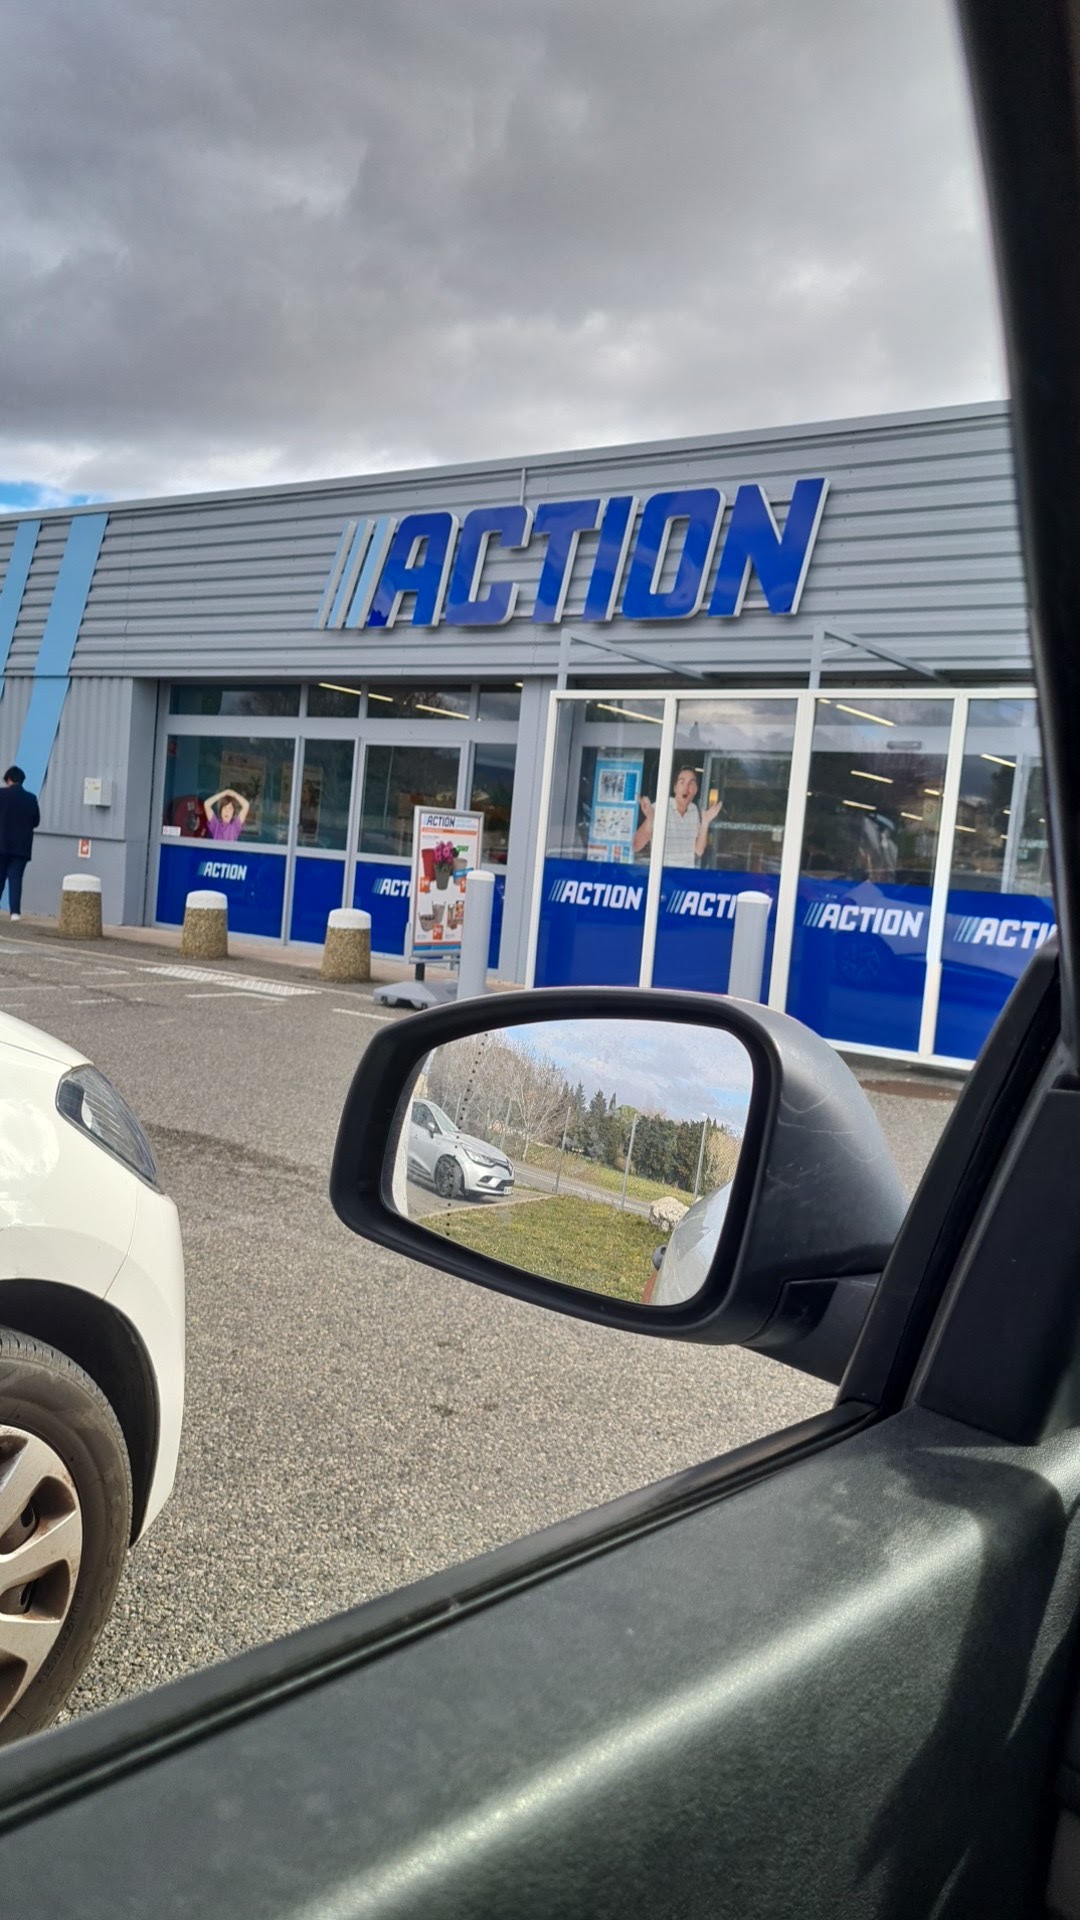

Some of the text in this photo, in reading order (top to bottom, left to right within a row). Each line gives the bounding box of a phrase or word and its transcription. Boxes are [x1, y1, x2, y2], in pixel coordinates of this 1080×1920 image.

[368, 478, 831, 628] ACTION
[427, 815, 455, 828] ACTION
[203, 861, 247, 881] ACTION
[560, 880, 643, 911] ACTION
[679, 891, 773, 919] ACTI
[818, 903, 924, 938] ACTION
